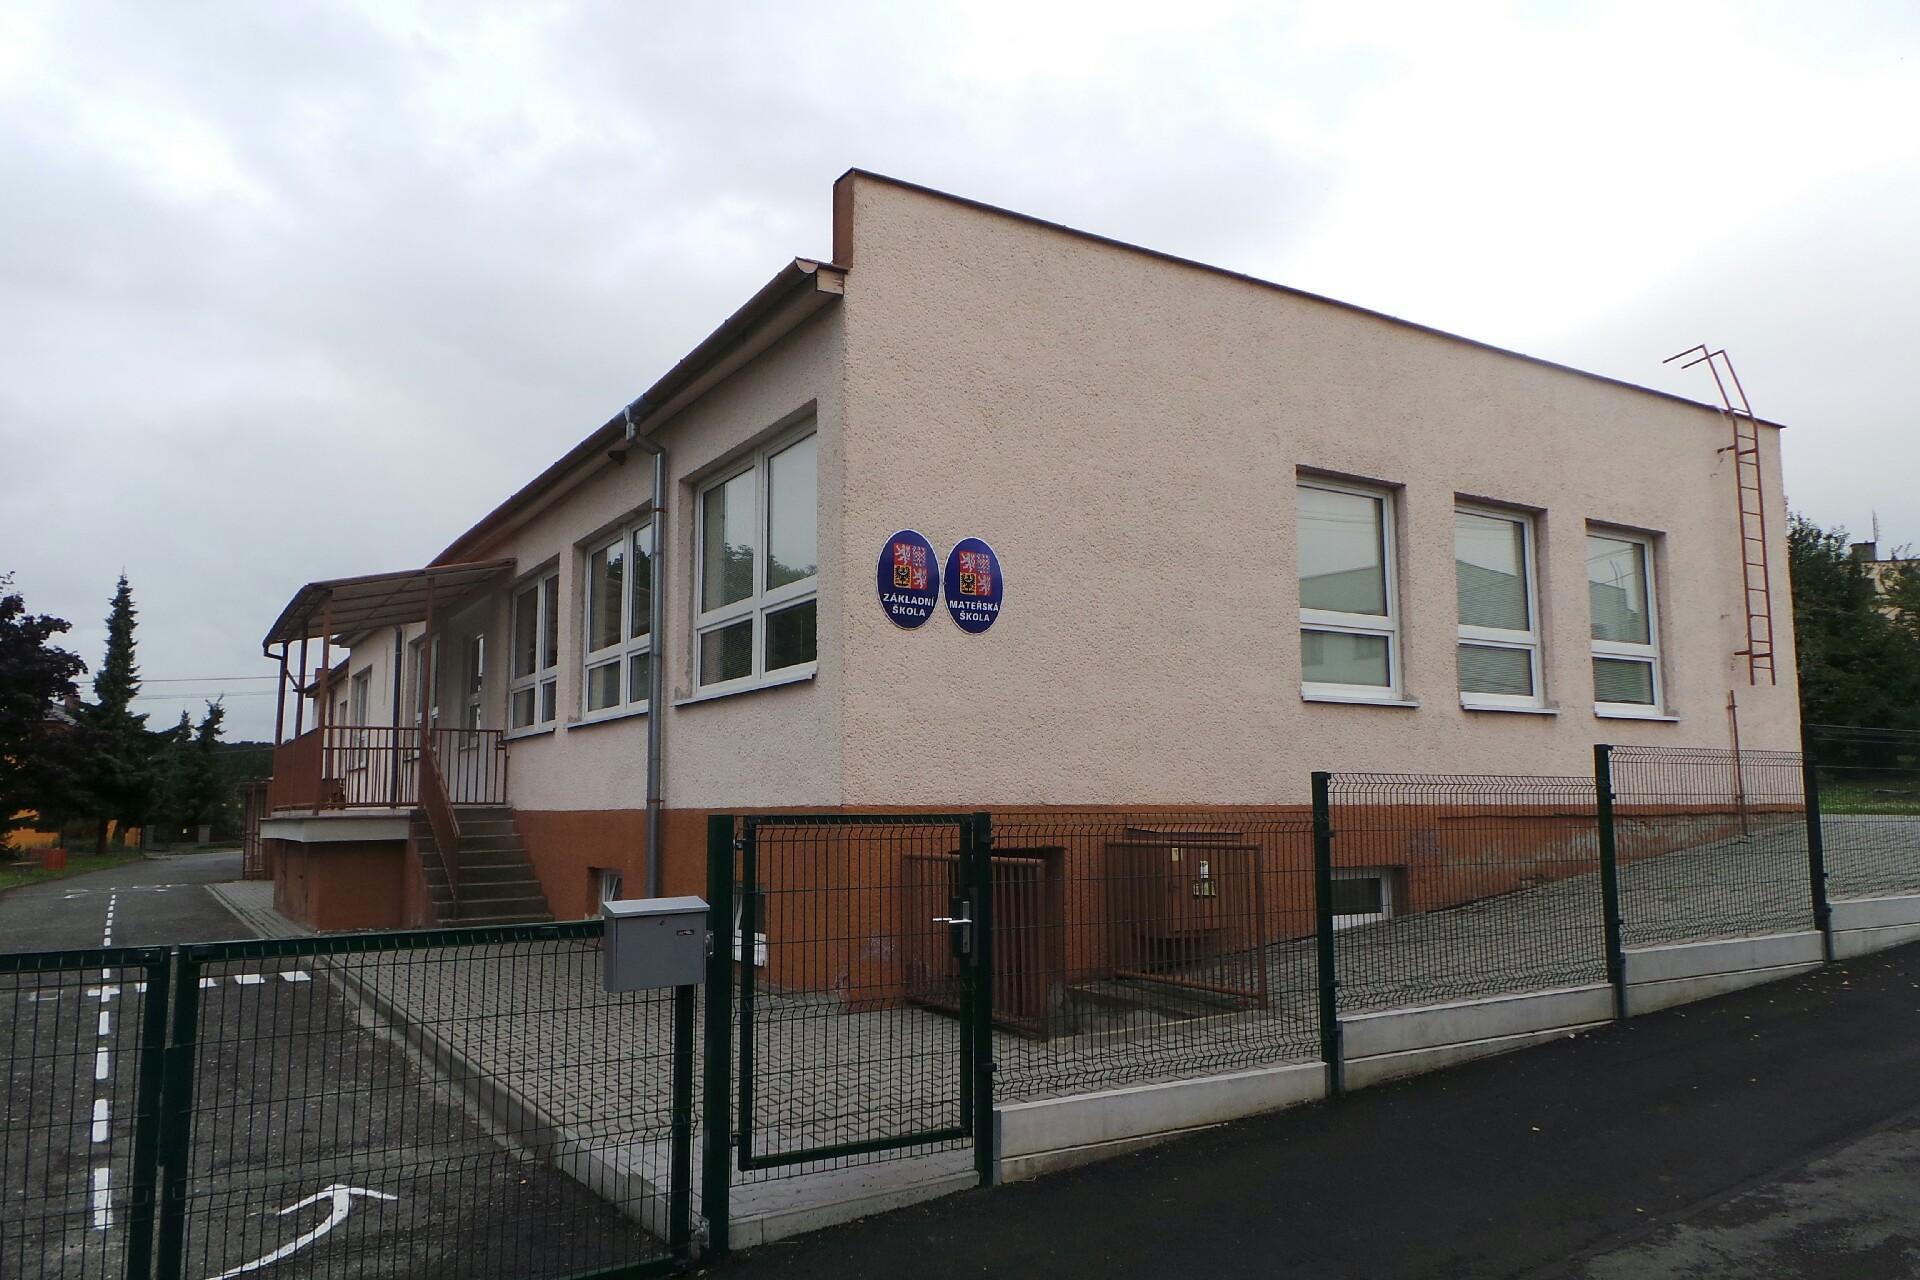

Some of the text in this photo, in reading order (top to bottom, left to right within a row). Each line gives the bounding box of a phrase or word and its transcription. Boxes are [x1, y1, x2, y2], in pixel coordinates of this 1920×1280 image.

[883, 592, 935, 607] ZÁKLADNÍ
[892, 605, 926, 617] ŠKOLA
[949, 600, 999, 612] MATEŘSKÁ
[959, 611, 990, 622] ŠKOLA
